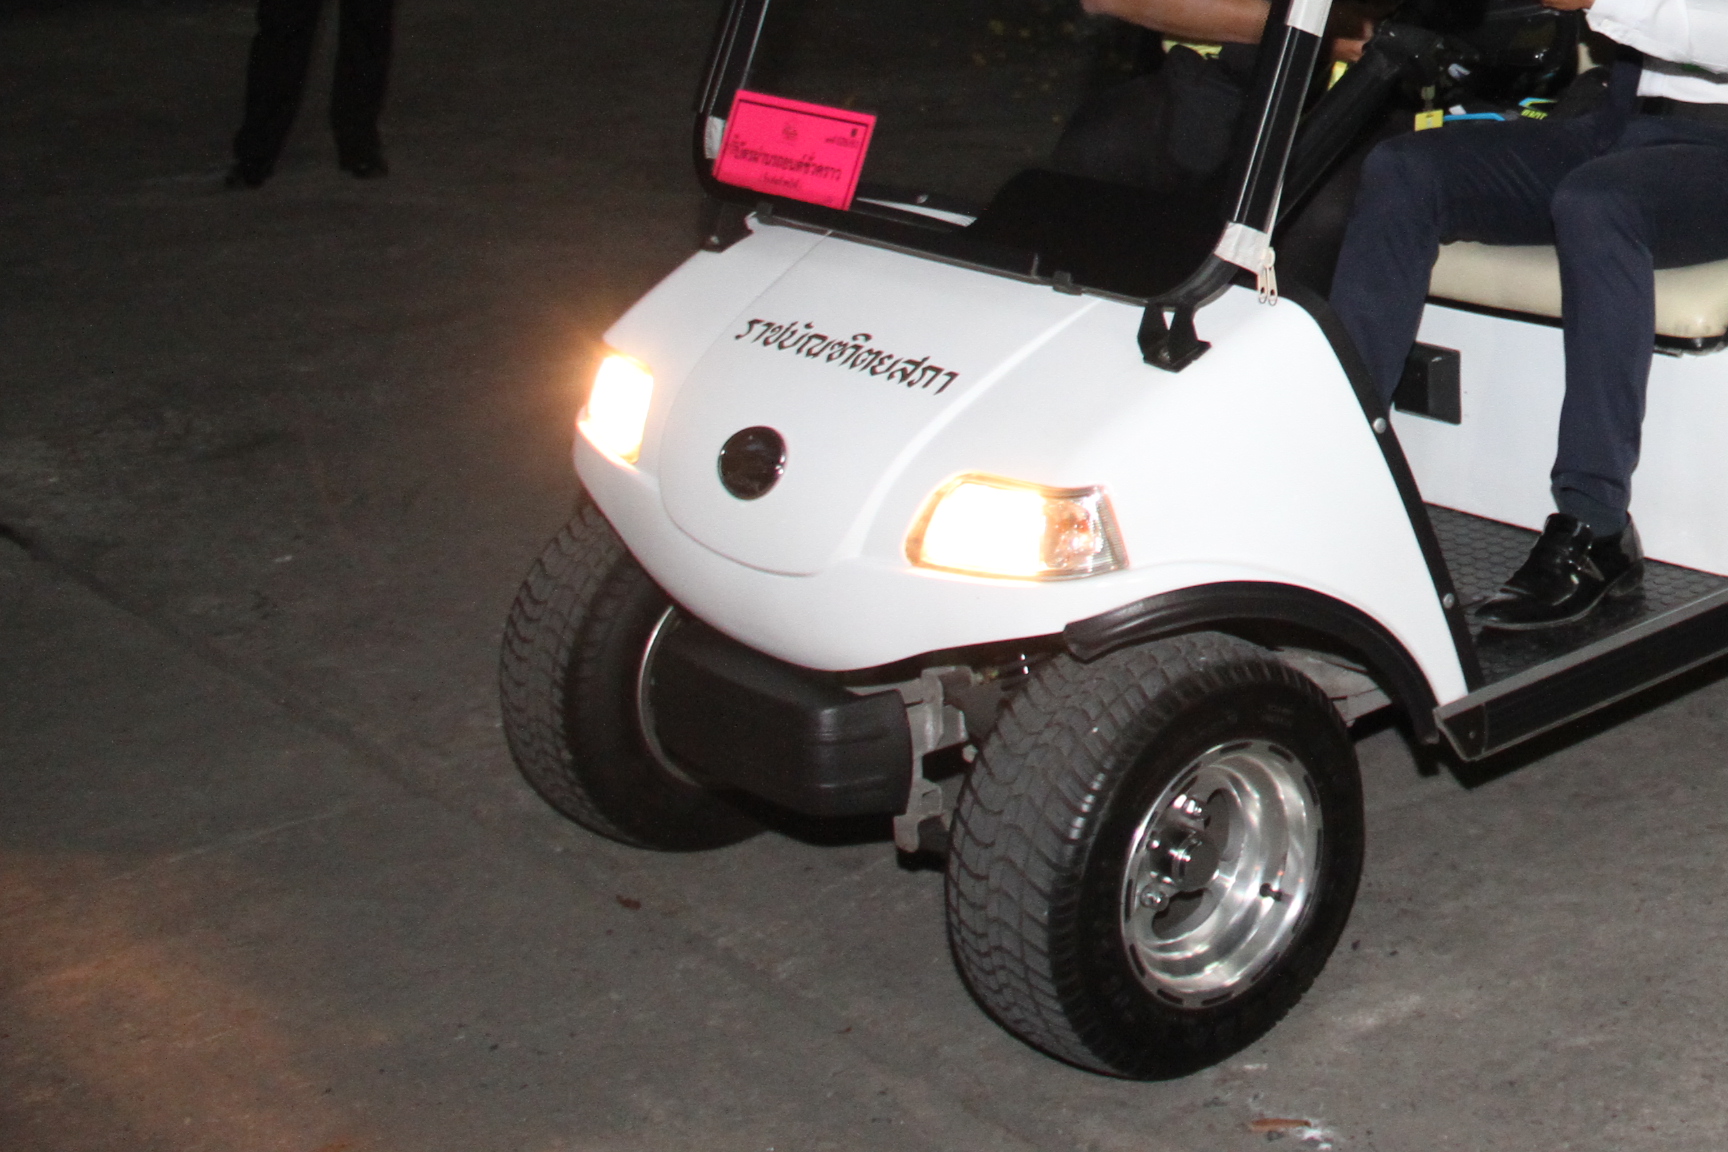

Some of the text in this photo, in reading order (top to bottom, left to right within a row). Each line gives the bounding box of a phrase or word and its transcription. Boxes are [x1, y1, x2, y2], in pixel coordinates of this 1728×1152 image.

[734, 318, 959, 395] ราชบัณฑิตยสภา
